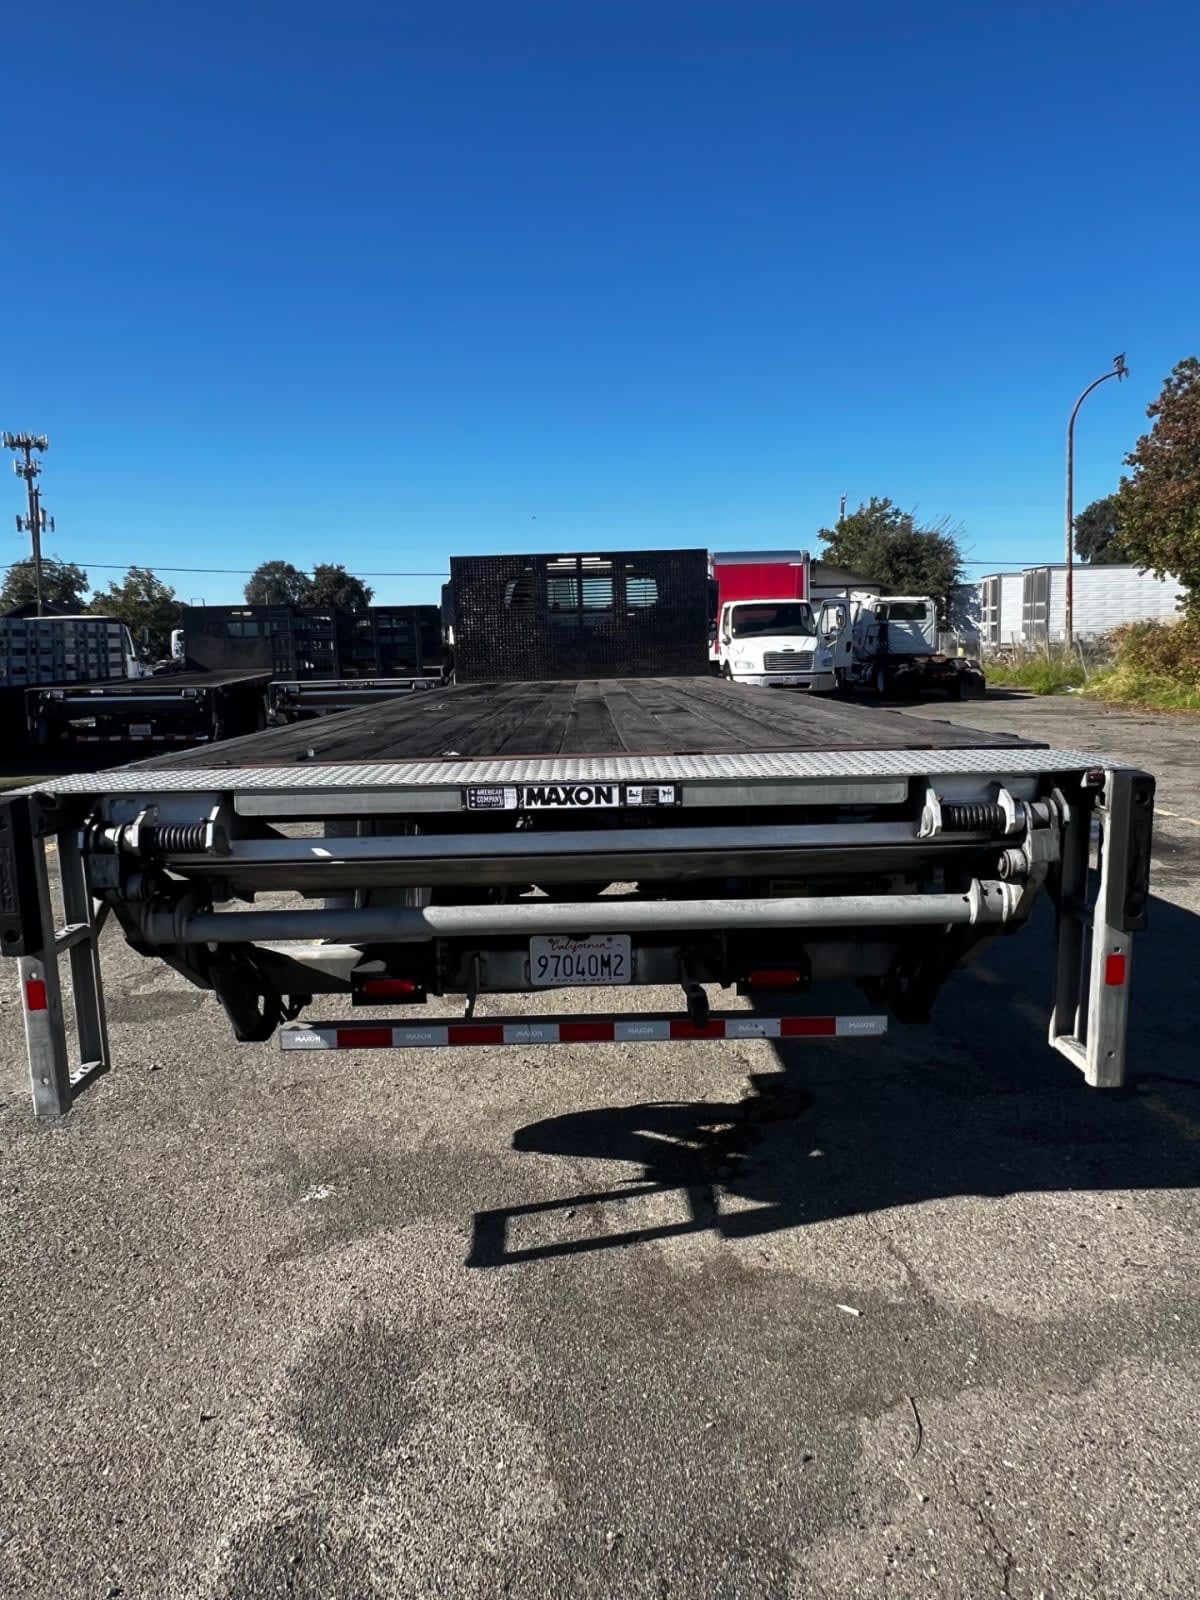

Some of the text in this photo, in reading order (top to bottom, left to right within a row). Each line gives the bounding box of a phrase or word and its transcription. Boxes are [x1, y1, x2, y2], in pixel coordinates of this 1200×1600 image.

[526, 786, 613, 806] MAXON
[550, 941, 611, 953] California
[537, 954, 624, 978] 97040M2
[294, 1035, 321, 1043] MAXON
[405, 1031, 432, 1041] MAXON
